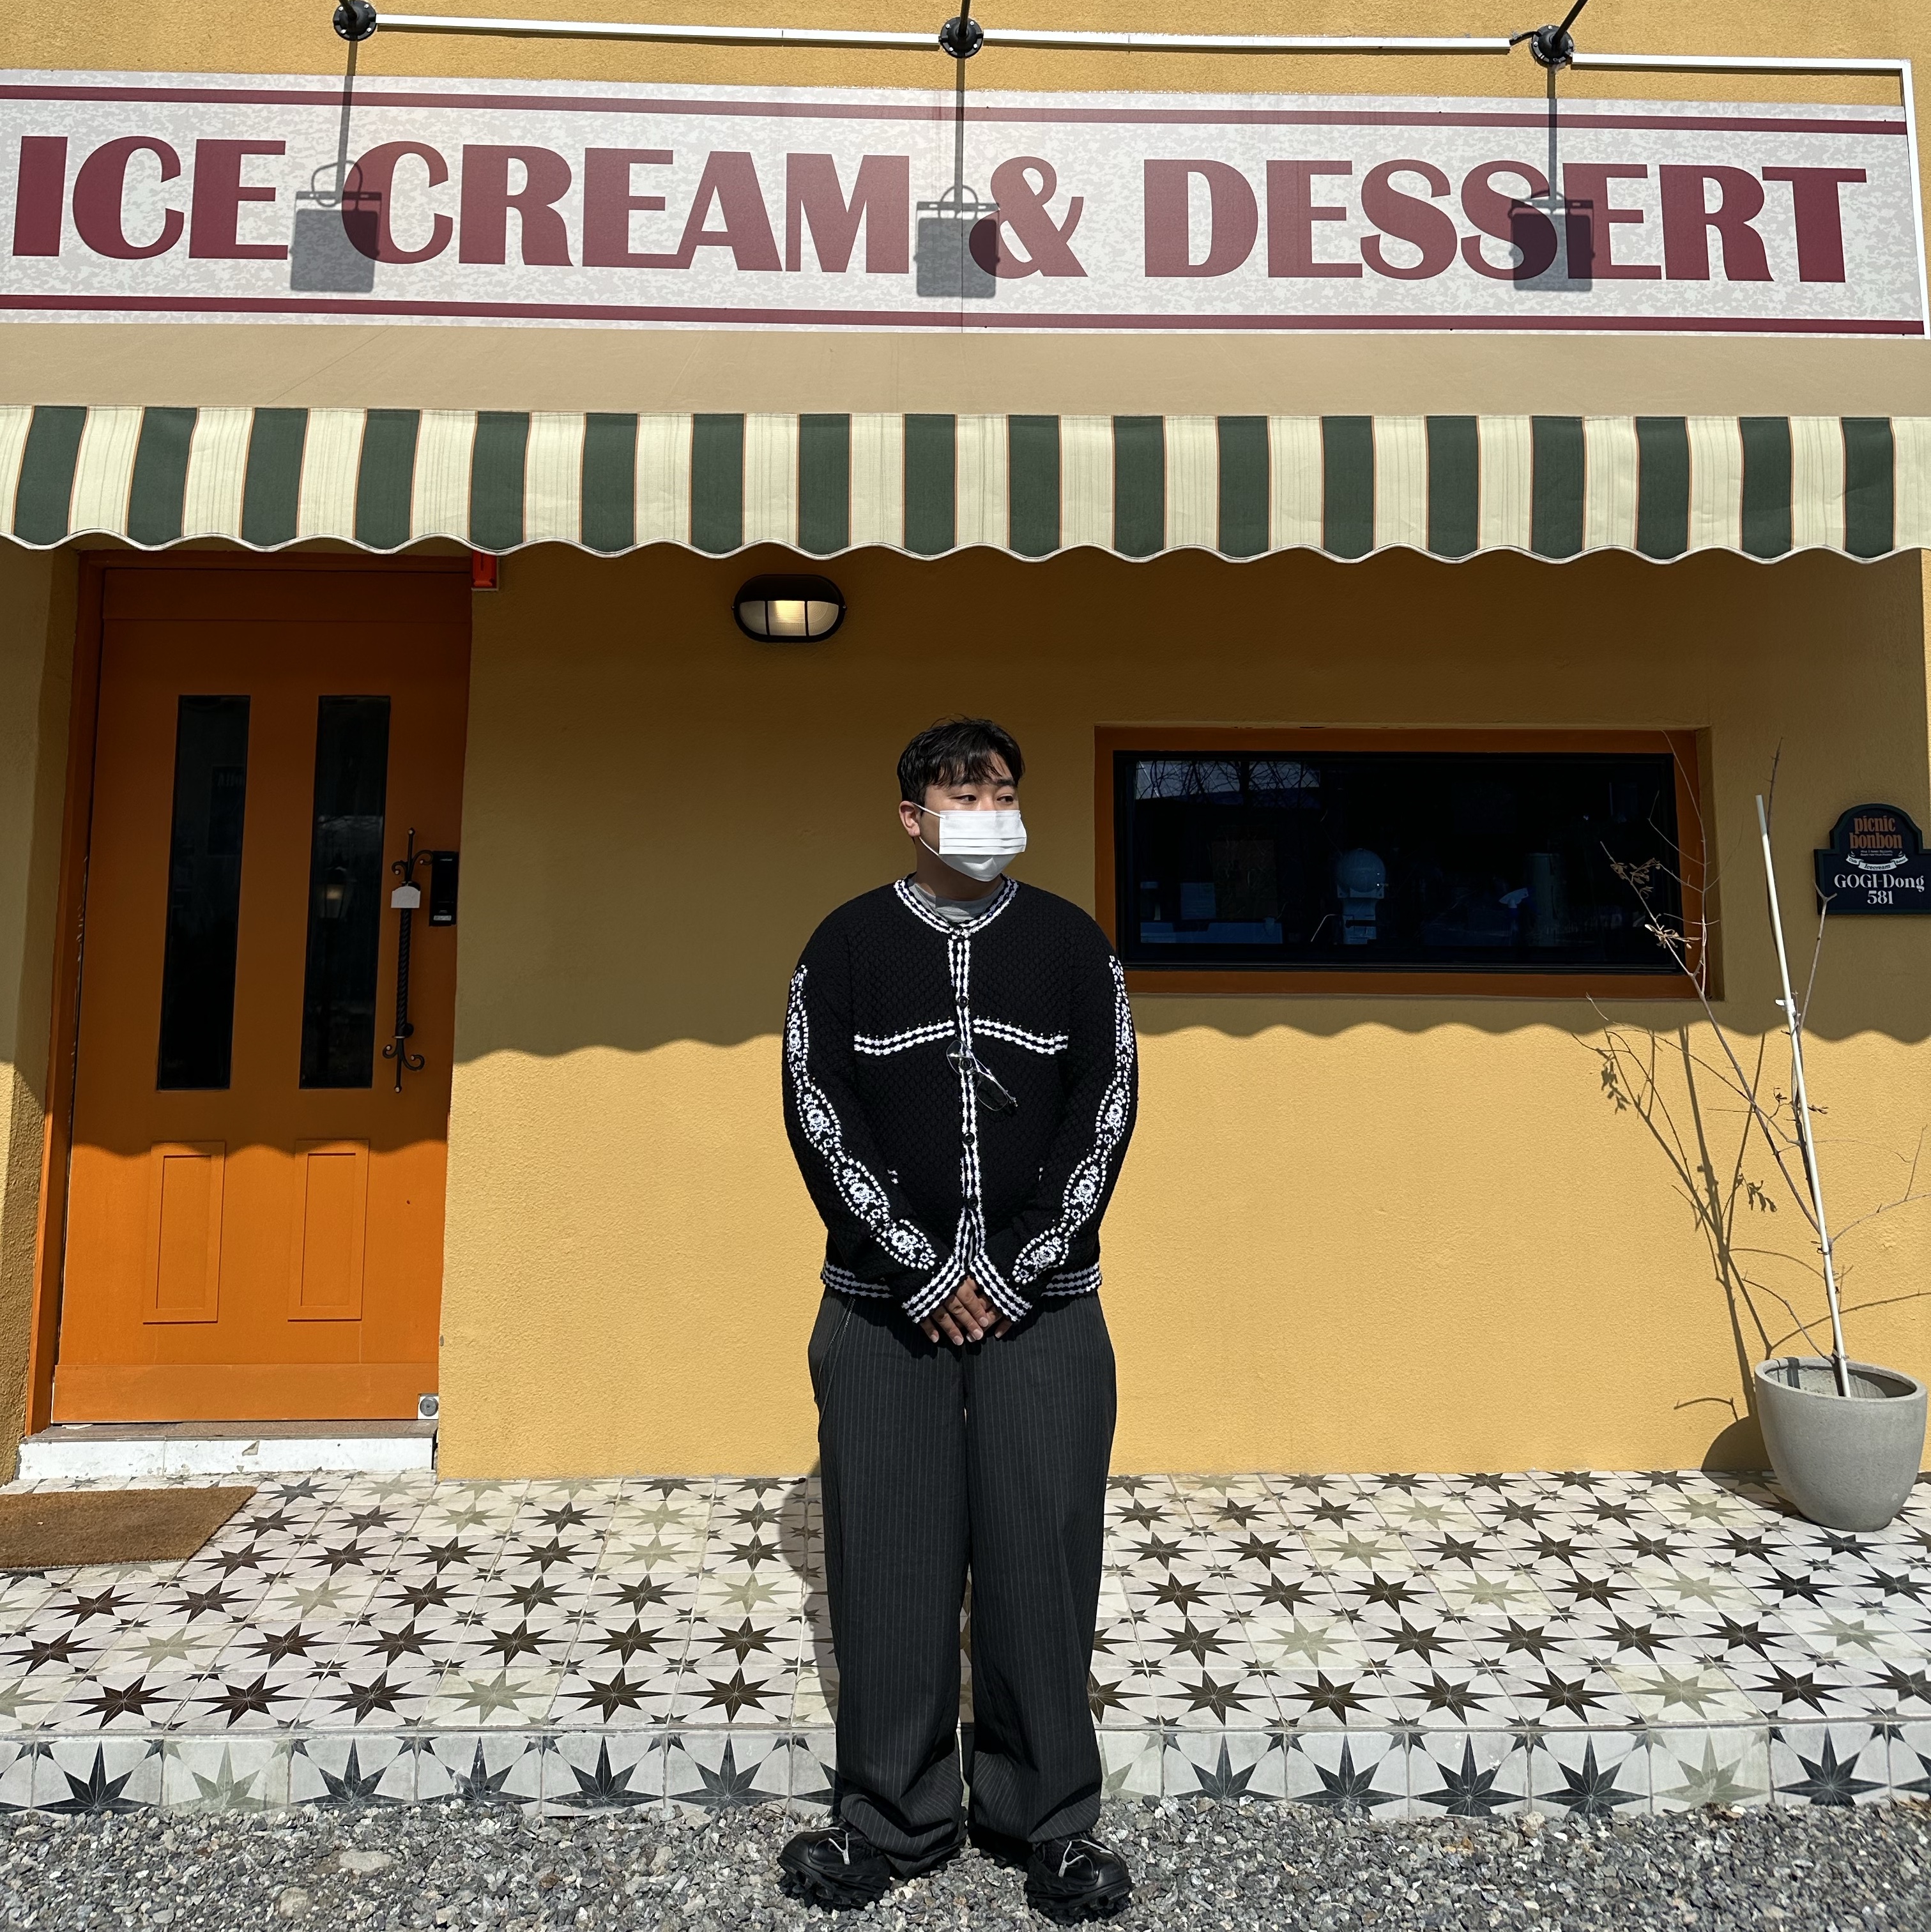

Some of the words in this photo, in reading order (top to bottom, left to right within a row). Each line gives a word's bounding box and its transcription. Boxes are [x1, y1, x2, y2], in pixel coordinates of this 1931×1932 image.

[13, 135, 289, 261] ICE
[342, 141, 910, 274] CREAM
[968, 156, 1088, 279] &
[1143, 158, 1867, 283] DESSERT
[1854, 816, 1896, 833] picnic
[1849, 832, 1903, 849] bonbon
[1834, 874, 1925, 892] GOGI-Dong
[1866, 890, 1894, 904] 581
